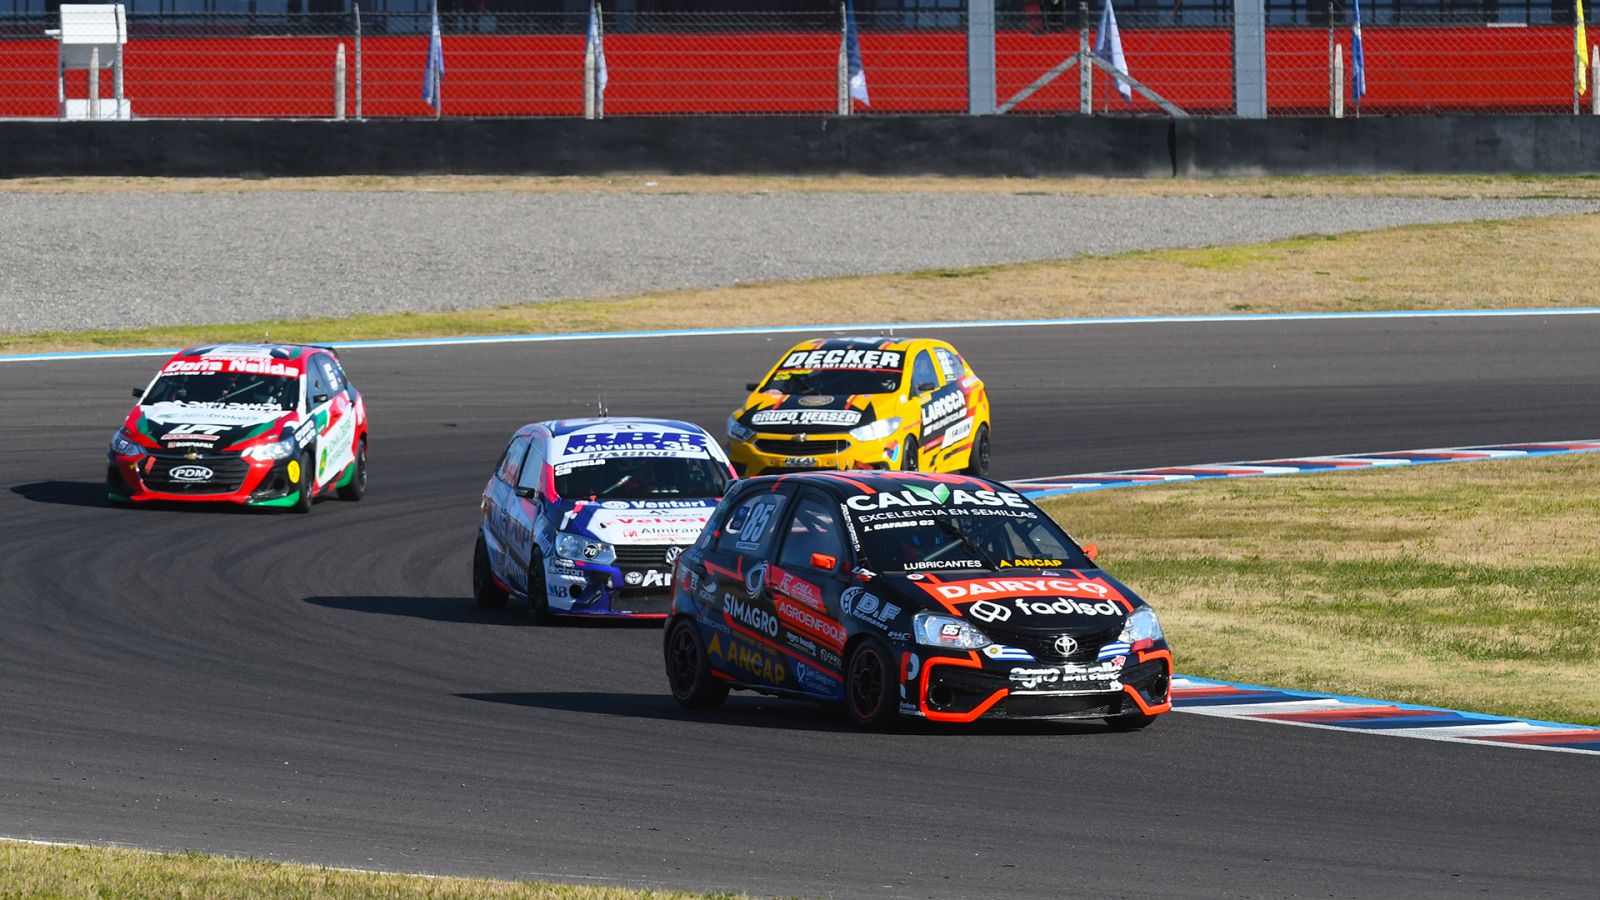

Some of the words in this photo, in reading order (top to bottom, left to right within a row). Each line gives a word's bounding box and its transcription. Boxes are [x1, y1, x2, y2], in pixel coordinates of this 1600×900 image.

[783, 350, 901, 368] DECKER
[752, 411, 800, 423] GRUPO
[567, 443, 657, 453] Válvulas
[662, 441, 701, 452] 3b
[175, 469, 207, 478] PDM
[631, 500, 706, 509] Venturi
[858, 509, 947, 523] EXCELENCIA
[948, 508, 969, 516] EN
[971, 508, 1037, 519] SEMILLAS
[741, 503, 776, 542] 85
[585, 548, 596, 556] 70
[904, 560, 983, 571] LUBRICANTES
[1015, 559, 1063, 568] ANCAP
[1015, 597, 1123, 616] fadisol
[722, 592, 779, 638] SIMAGRO
[779, 601, 847, 645] AGROENFOQUE
[942, 624, 961, 635] 85
[728, 641, 785, 685] ANCAP
